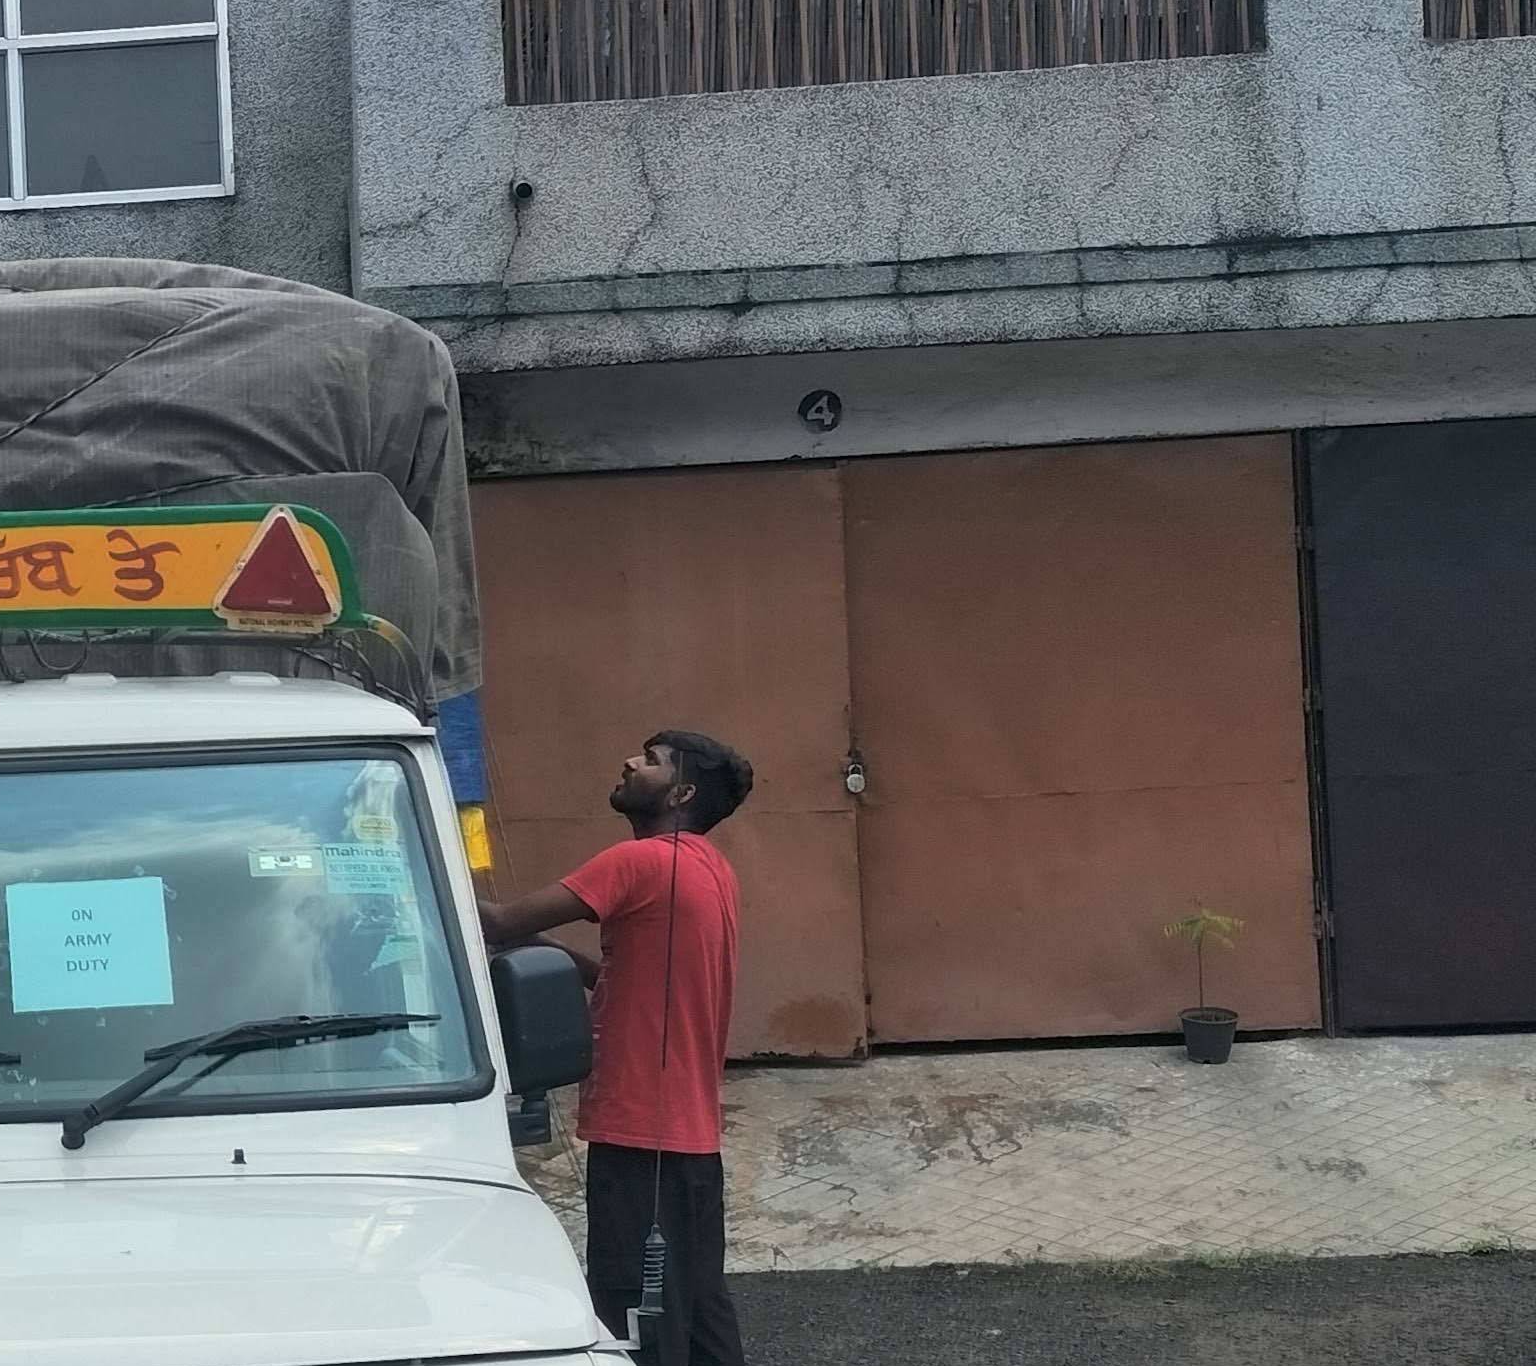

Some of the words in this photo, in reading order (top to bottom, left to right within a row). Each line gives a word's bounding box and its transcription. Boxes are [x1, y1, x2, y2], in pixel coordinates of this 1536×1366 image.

[806, 395, 835, 426] 4
[106, 528, 182, 602] ਤੇ
[64, 933, 112, 947] ARMY
[66, 959, 109, 972] DUTY
